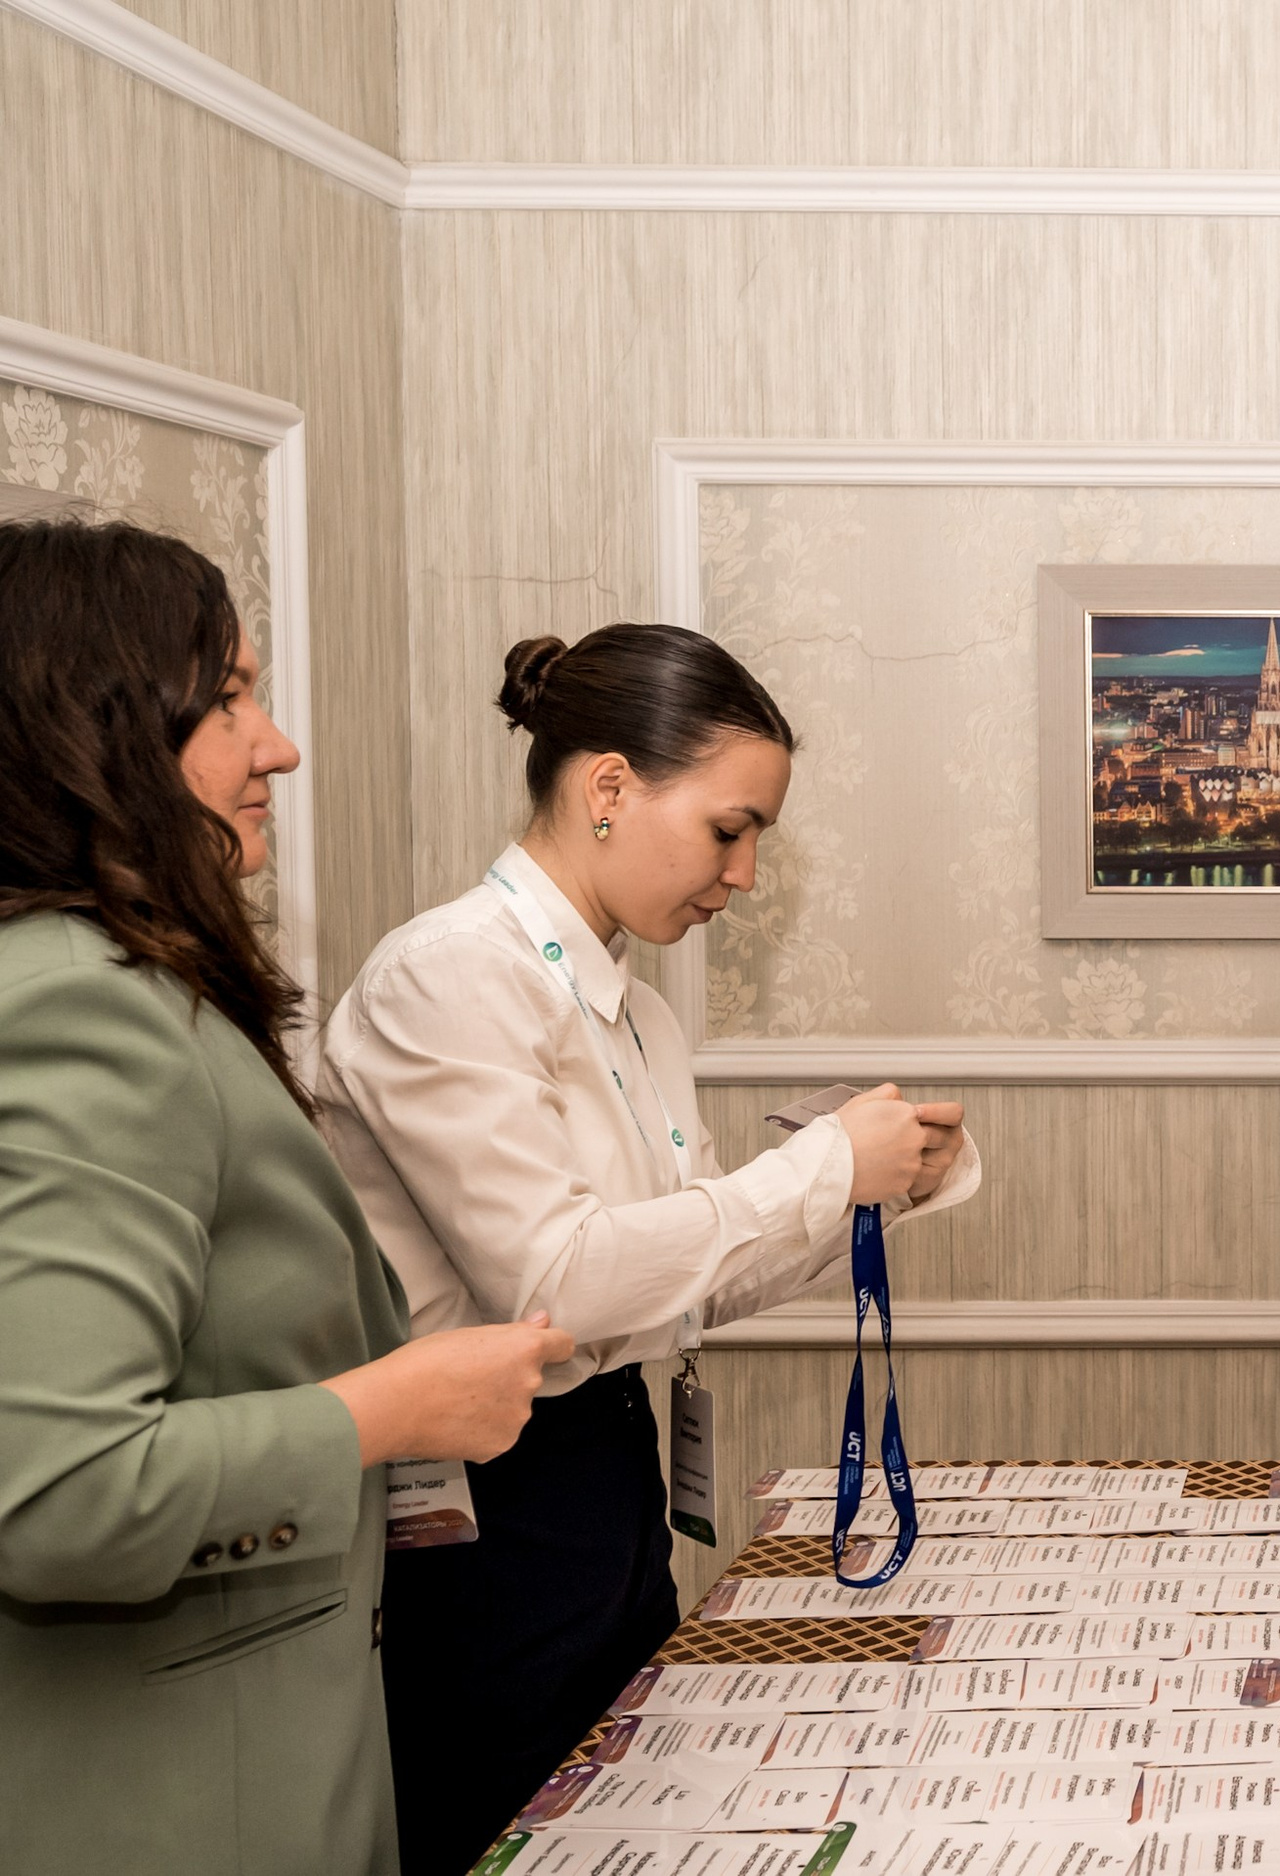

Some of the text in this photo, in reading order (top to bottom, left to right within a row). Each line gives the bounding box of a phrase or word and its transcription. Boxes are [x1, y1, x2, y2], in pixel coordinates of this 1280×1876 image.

[847, 1431, 861, 1461] UCT
[414, 1479, 446, 1491] Лидер
[891, 1472, 907, 1492] UCT
[881, 1550, 905, 1580] UCT
